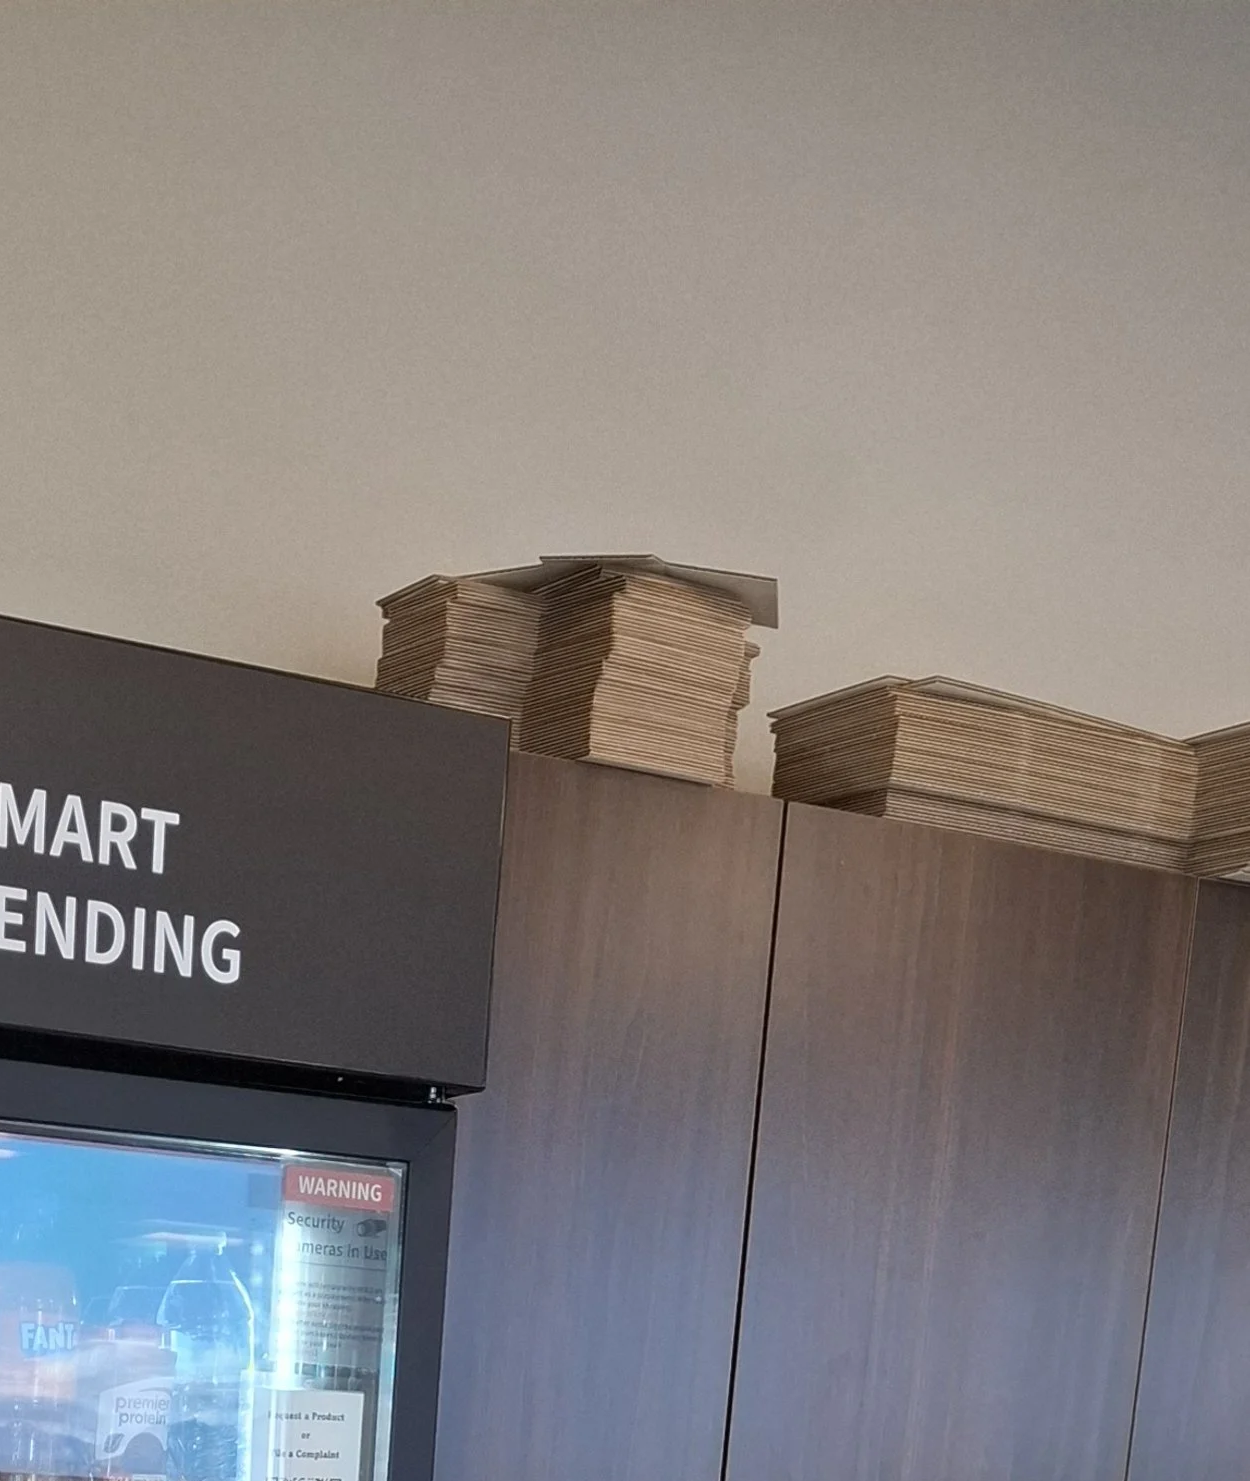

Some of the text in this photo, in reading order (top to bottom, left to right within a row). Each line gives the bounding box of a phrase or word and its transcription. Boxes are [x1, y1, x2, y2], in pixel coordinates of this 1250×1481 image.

[299, 1175, 383, 1202] WARNING
[288, 1211, 345, 1234] Security
[364, 1248, 388, 1261] Use
[21, 1321, 75, 1351] FANT
[118, 1410, 167, 1427] protein
[312, 1411, 345, 1421] Product
[295, 1450, 339, 1461] Complaint
